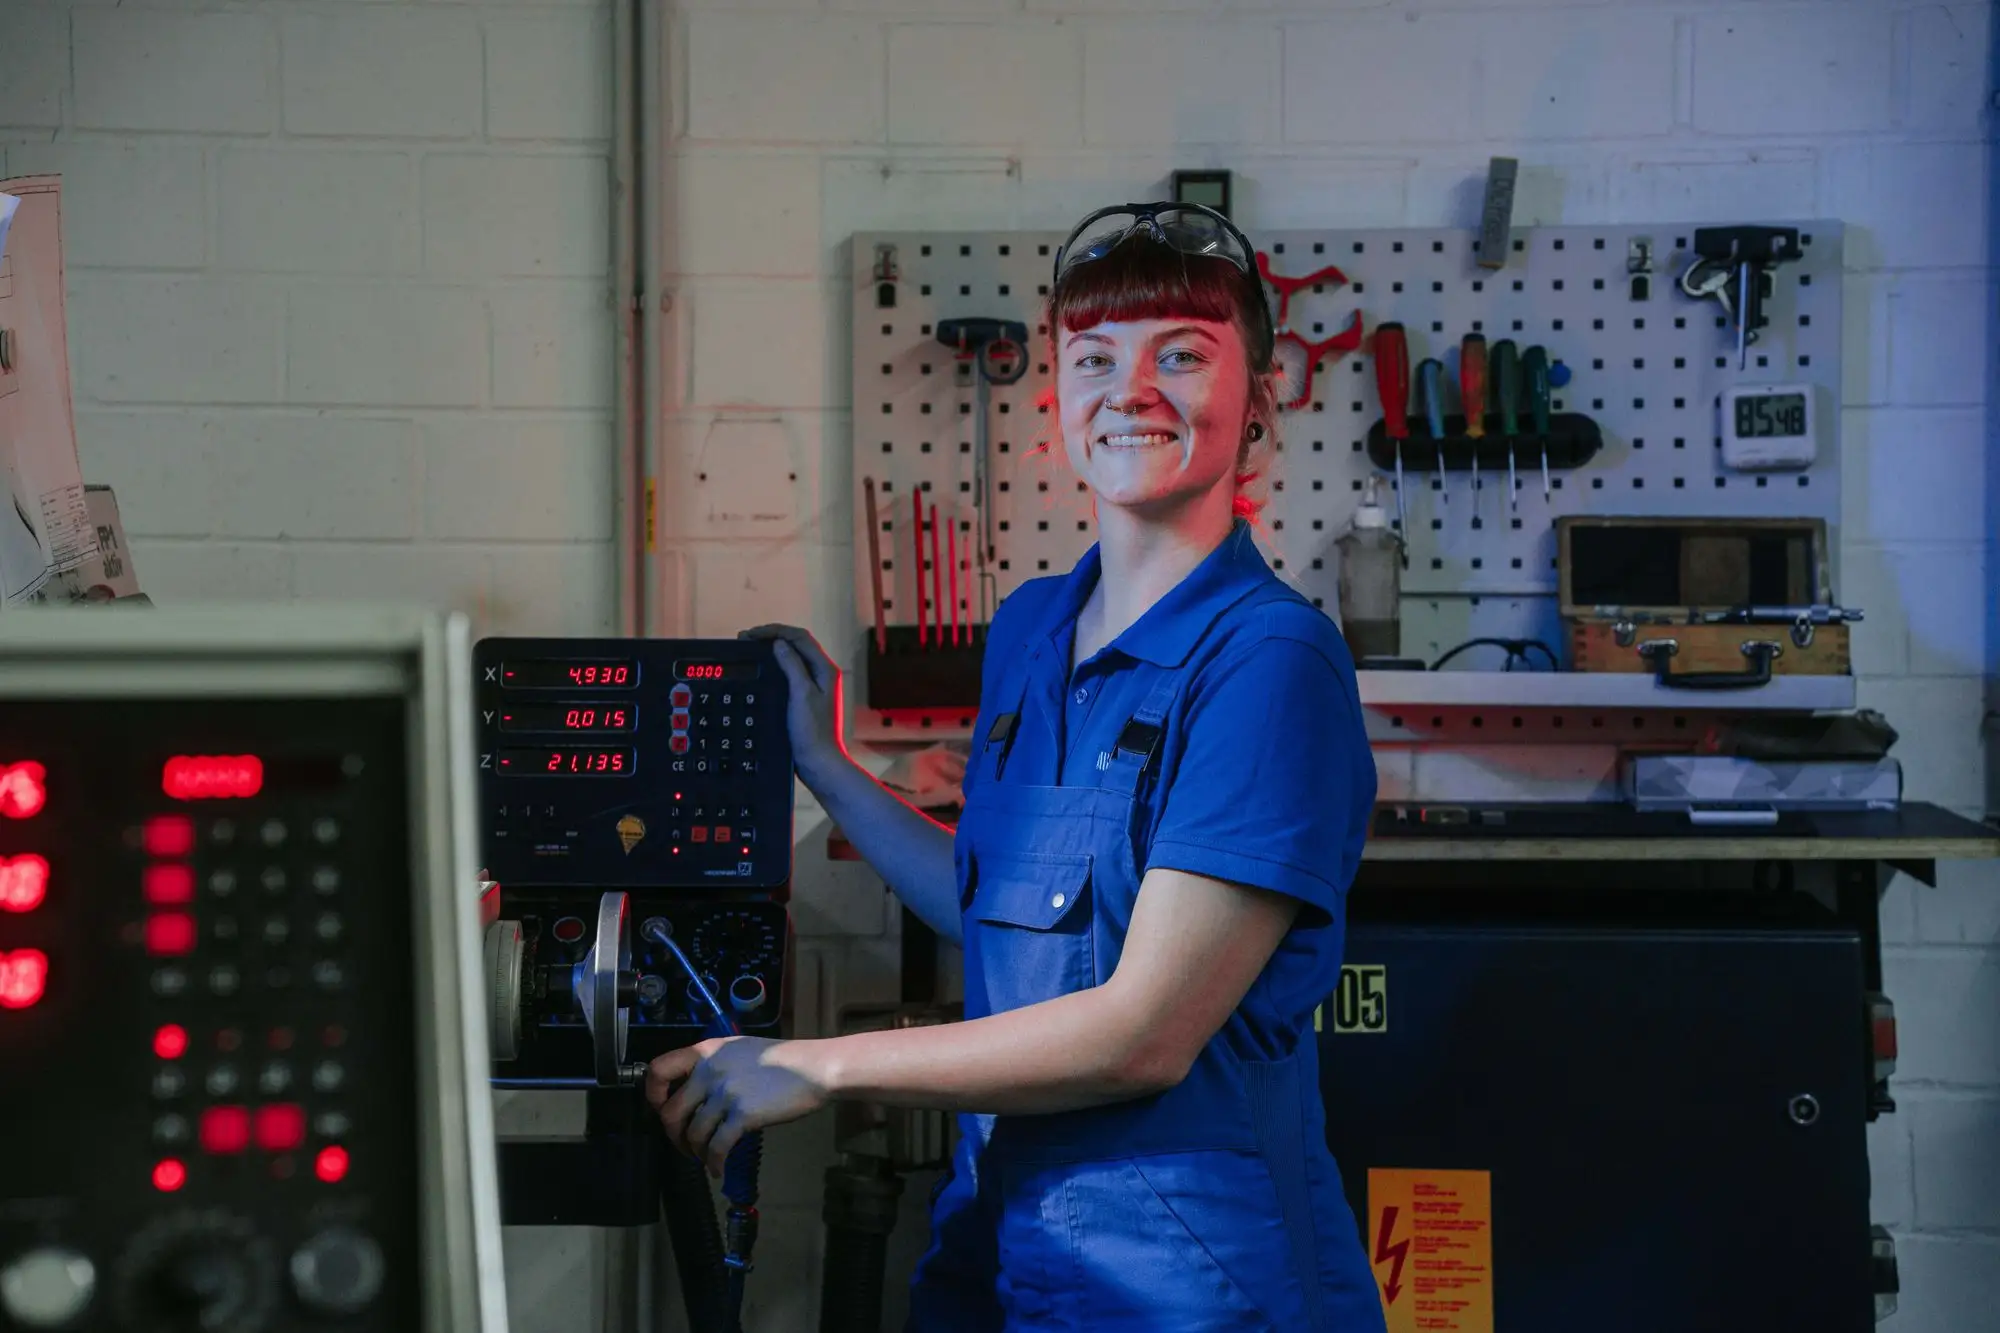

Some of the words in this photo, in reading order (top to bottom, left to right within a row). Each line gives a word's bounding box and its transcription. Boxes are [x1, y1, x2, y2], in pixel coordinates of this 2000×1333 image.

[484, 667, 496, 681] X
[699, 693, 709, 704] 7
[723, 693, 732, 704] 8
[746, 693, 755, 704] 9
[483, 710, 494, 724] Y
[699, 716, 708, 727] 4
[722, 716, 731, 726] 5
[745, 716, 754, 726] 6
[699, 738, 706, 749] 1
[721, 739, 730, 749] 2
[745, 739, 753, 749] 3
[480, 754, 491, 768] Z
[672, 760, 685, 772] CE
[1336, 968, 1384, 1029] 05
